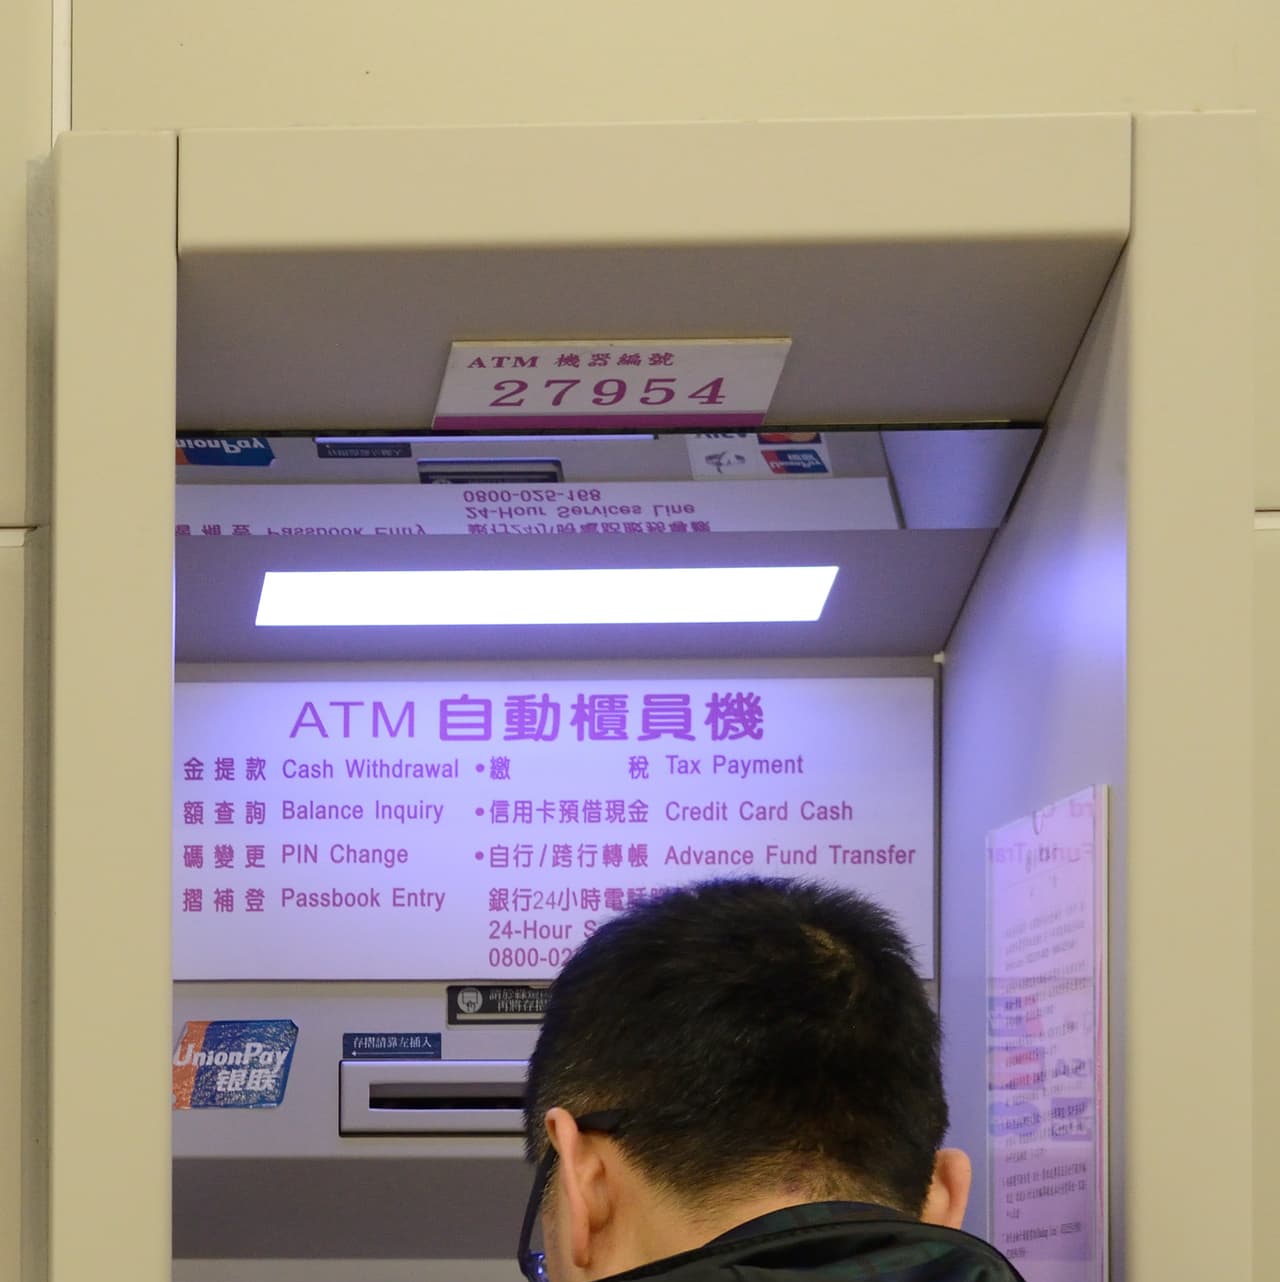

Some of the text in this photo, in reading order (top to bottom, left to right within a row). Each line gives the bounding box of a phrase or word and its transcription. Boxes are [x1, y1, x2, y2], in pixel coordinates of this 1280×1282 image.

[467, 352, 675, 369] ATM 機器編號
[489, 377, 727, 407] 27954
[289, 693, 764, 742] ATM 自動櫃員機
[282, 759, 333, 779] Cash
[346, 758, 459, 779] Withdrawal
[666, 755, 701, 775] Tax
[713, 754, 804, 779] Payment
[282, 800, 363, 820] Balance
[376, 800, 444, 824] Inquiry
[490, 799, 853, 825] 信用卡預借現金 Credit Card Cash
[282, 844, 318, 864] PIN
[330, 844, 409, 868] Change
[664, 845, 754, 866] Advance
[766, 845, 817, 866] Fund
[829, 844, 916, 866] Transfer
[282, 888, 380, 908] Passbook
[393, 888, 446, 913] Entry
[489, 920, 572, 941] 24-Hour
[173, 1042, 288, 1075] UnionPay
